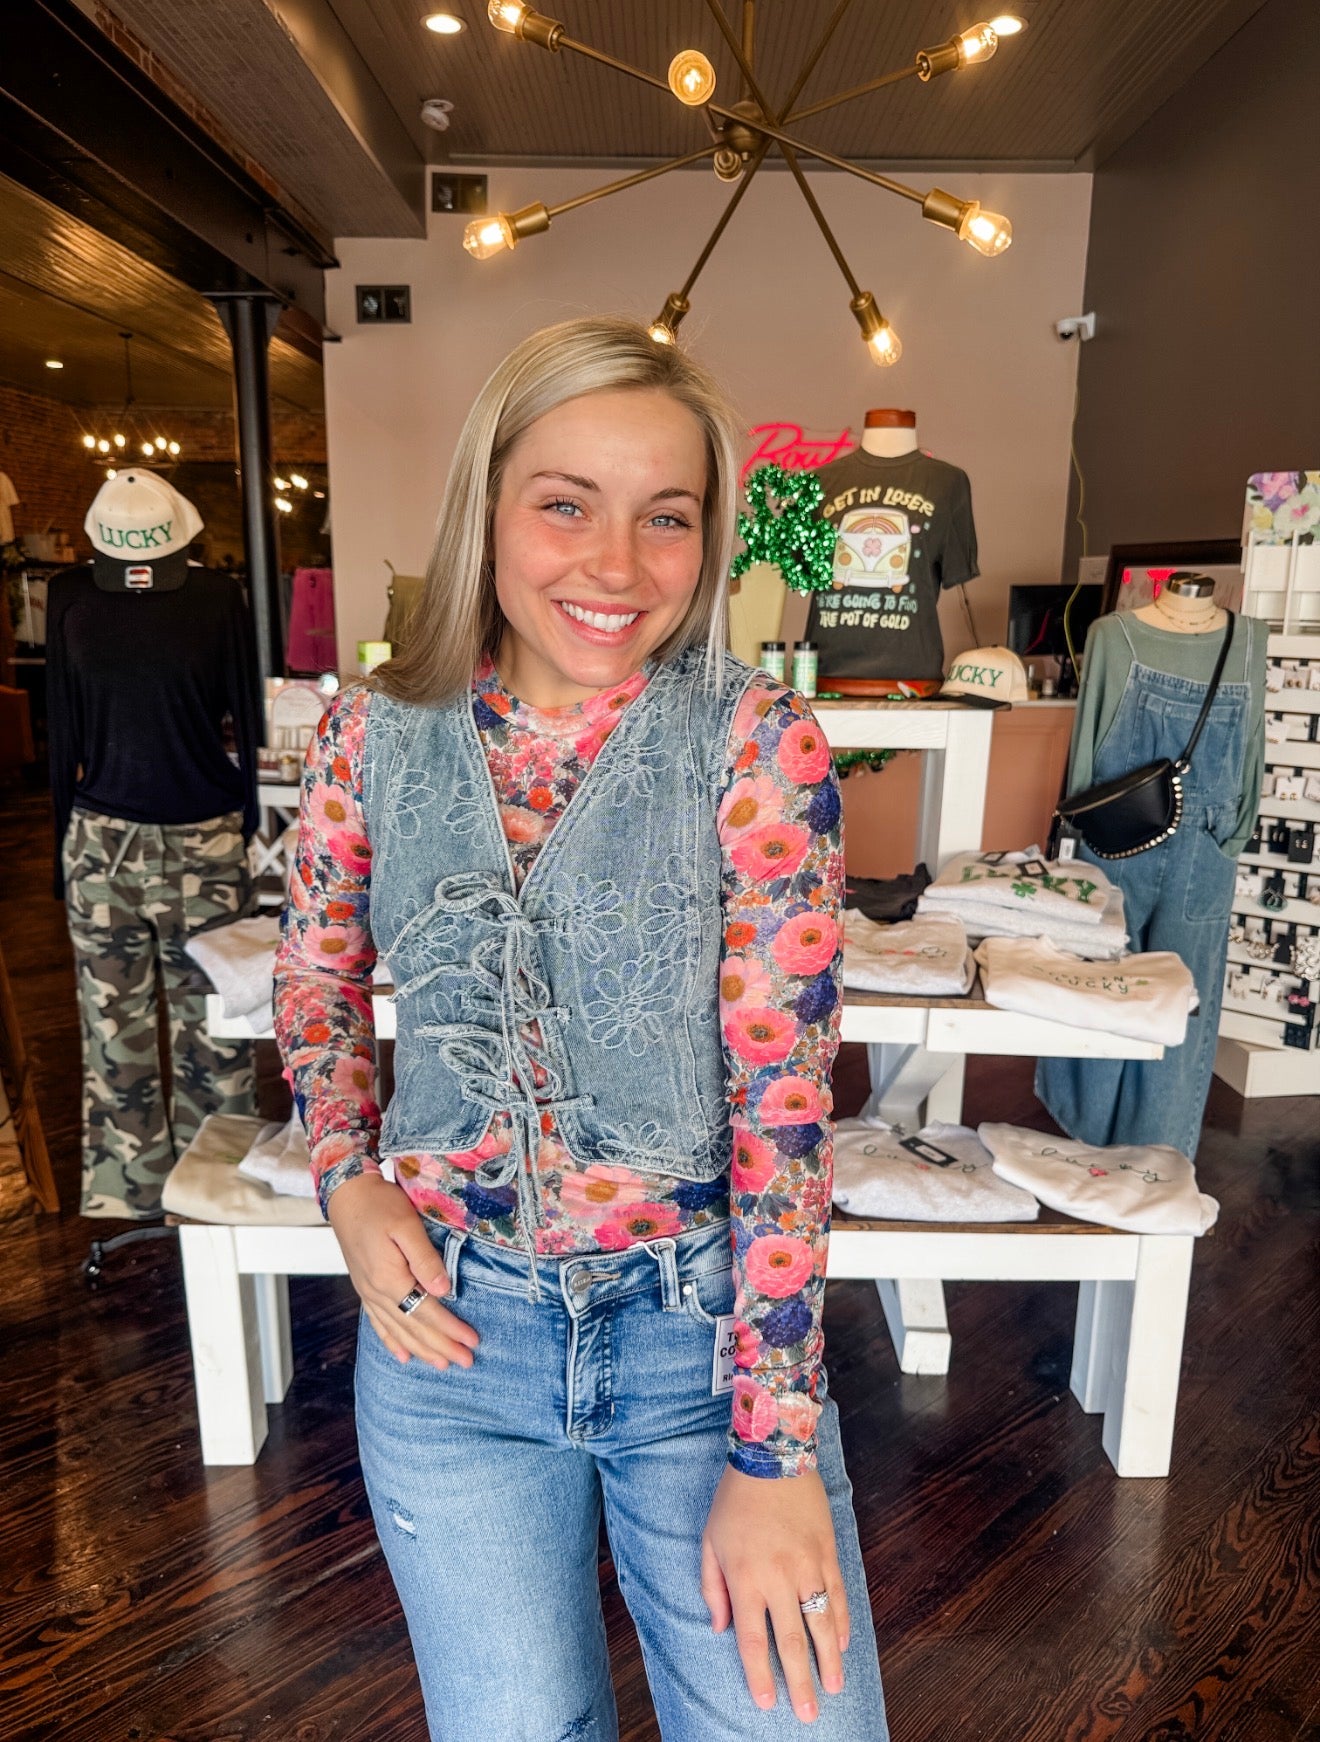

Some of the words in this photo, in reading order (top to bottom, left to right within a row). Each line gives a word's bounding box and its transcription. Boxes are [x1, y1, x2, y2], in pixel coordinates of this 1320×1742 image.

[823, 486, 858, 518] GET
[860, 486, 881, 504] IN
[883, 487, 934, 517] LOSER
[98, 521, 172, 549] LUCKY
[843, 593, 881, 610] GOING
[884, 595, 896, 610] TO
[820, 611, 839, 628] THE
[840, 610, 863, 626] POT
[863, 612, 879, 628] OF
[880, 614, 910, 630] GOLD
